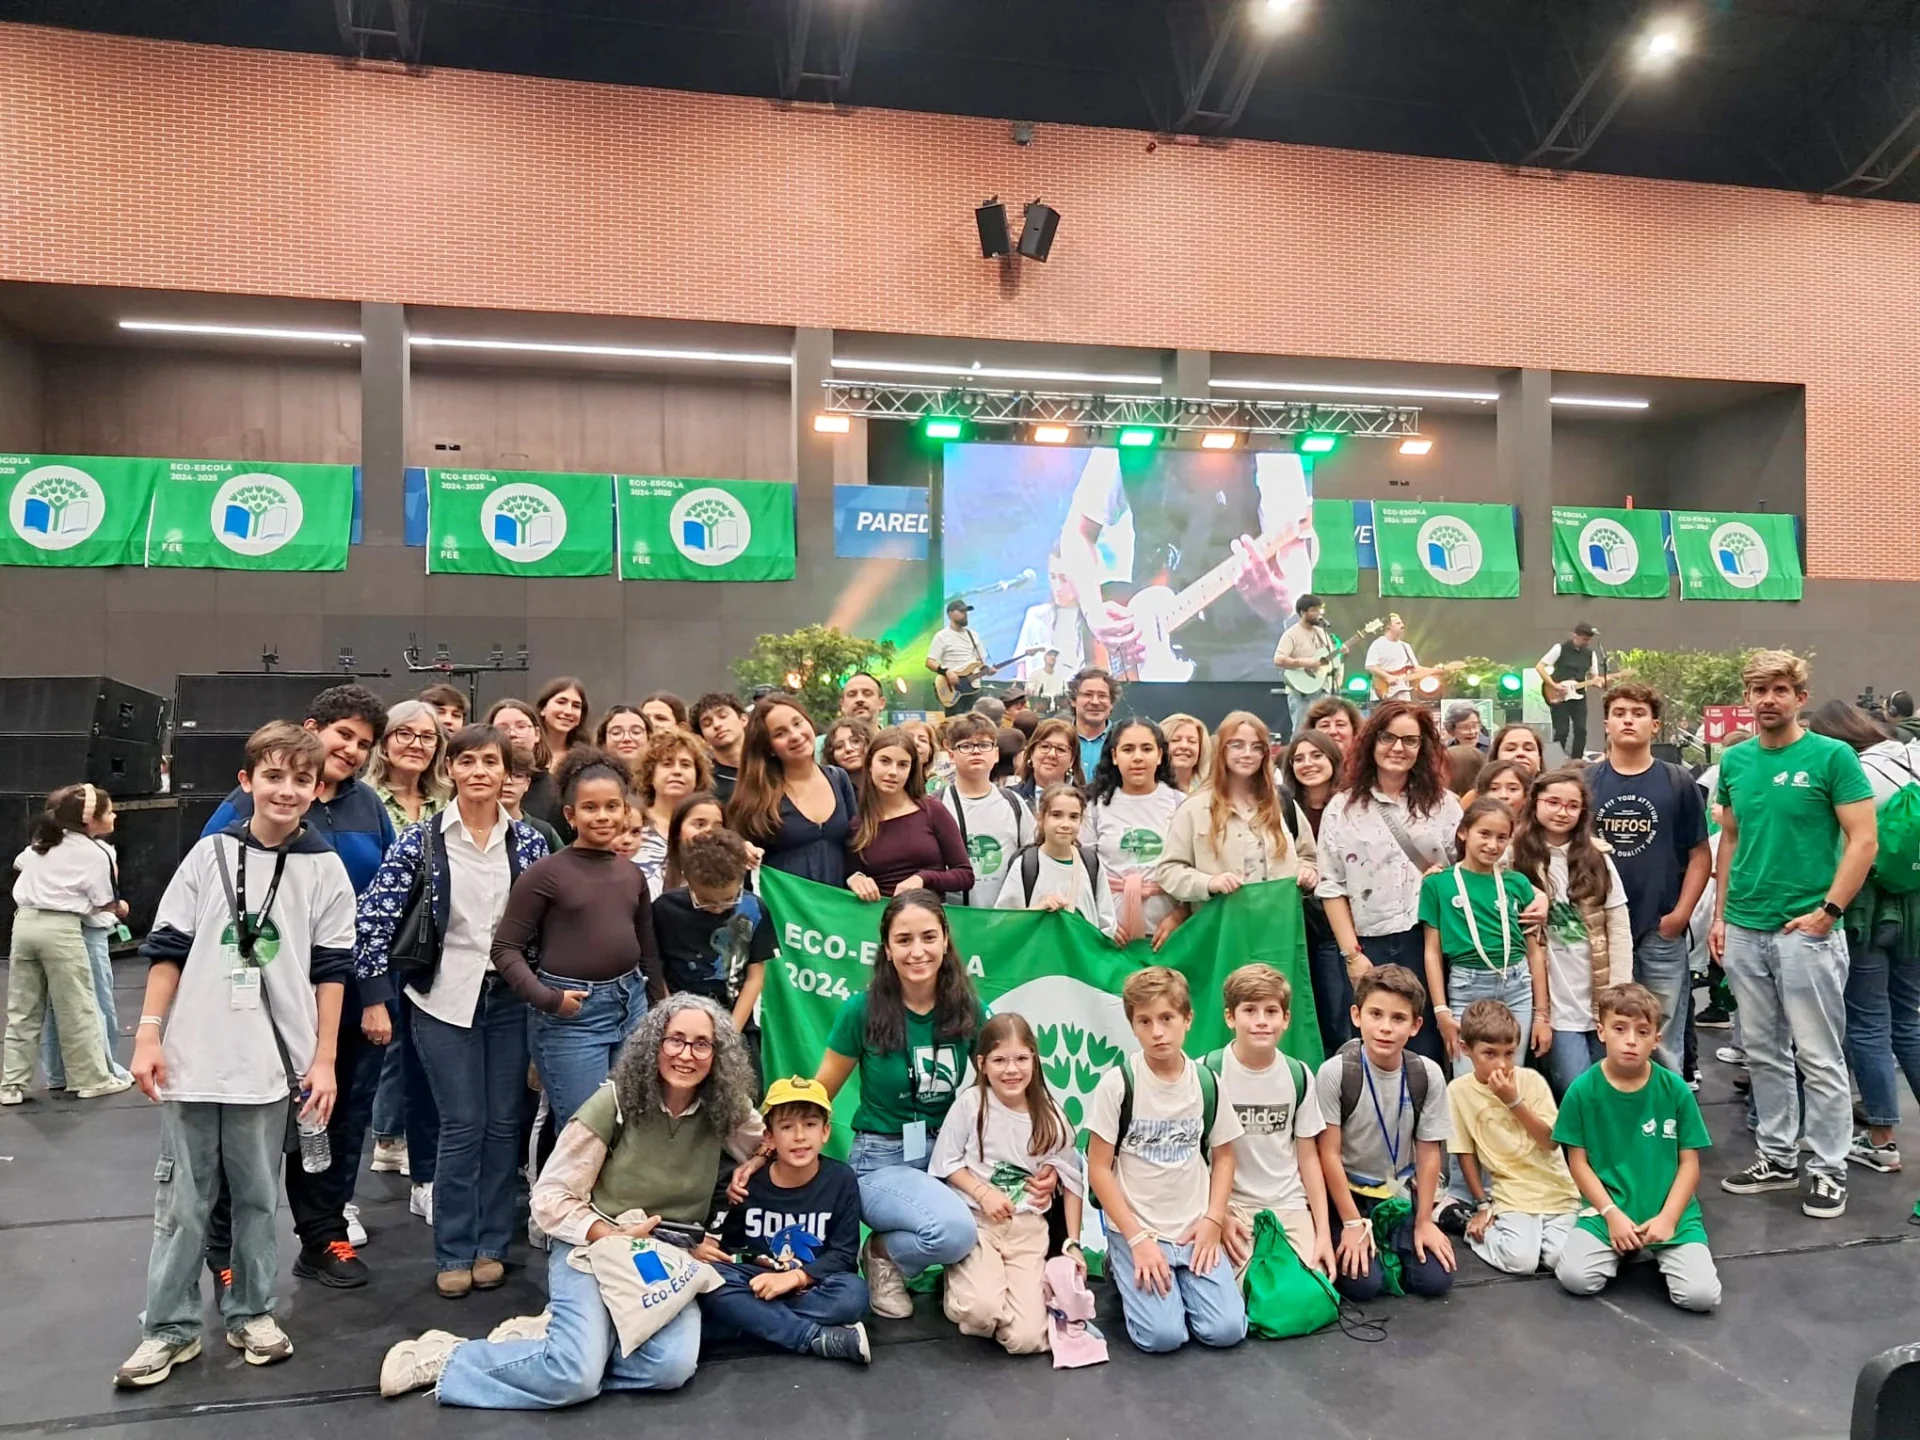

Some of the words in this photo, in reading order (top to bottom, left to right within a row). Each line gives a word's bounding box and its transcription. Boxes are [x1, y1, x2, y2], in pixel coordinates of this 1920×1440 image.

[170, 462, 233, 472] ECO-ESCOLA
[170, 473, 218, 482] 2024-2025
[440, 472, 498, 483] ECO-ESCOLA
[441, 482, 485, 490] 2024-2025
[628, 479, 684, 489] ECO-ESCOLA
[630, 488, 673, 497] 2024-2025
[161, 543, 184, 553] FEE
[440, 550, 460, 559] FEE
[632, 555, 652, 565] FEE
[1616, 794, 1636, 802] YOUR
[1602, 818, 1652, 832] TIFFOSI
[1236, 1108, 1287, 1125] didas
